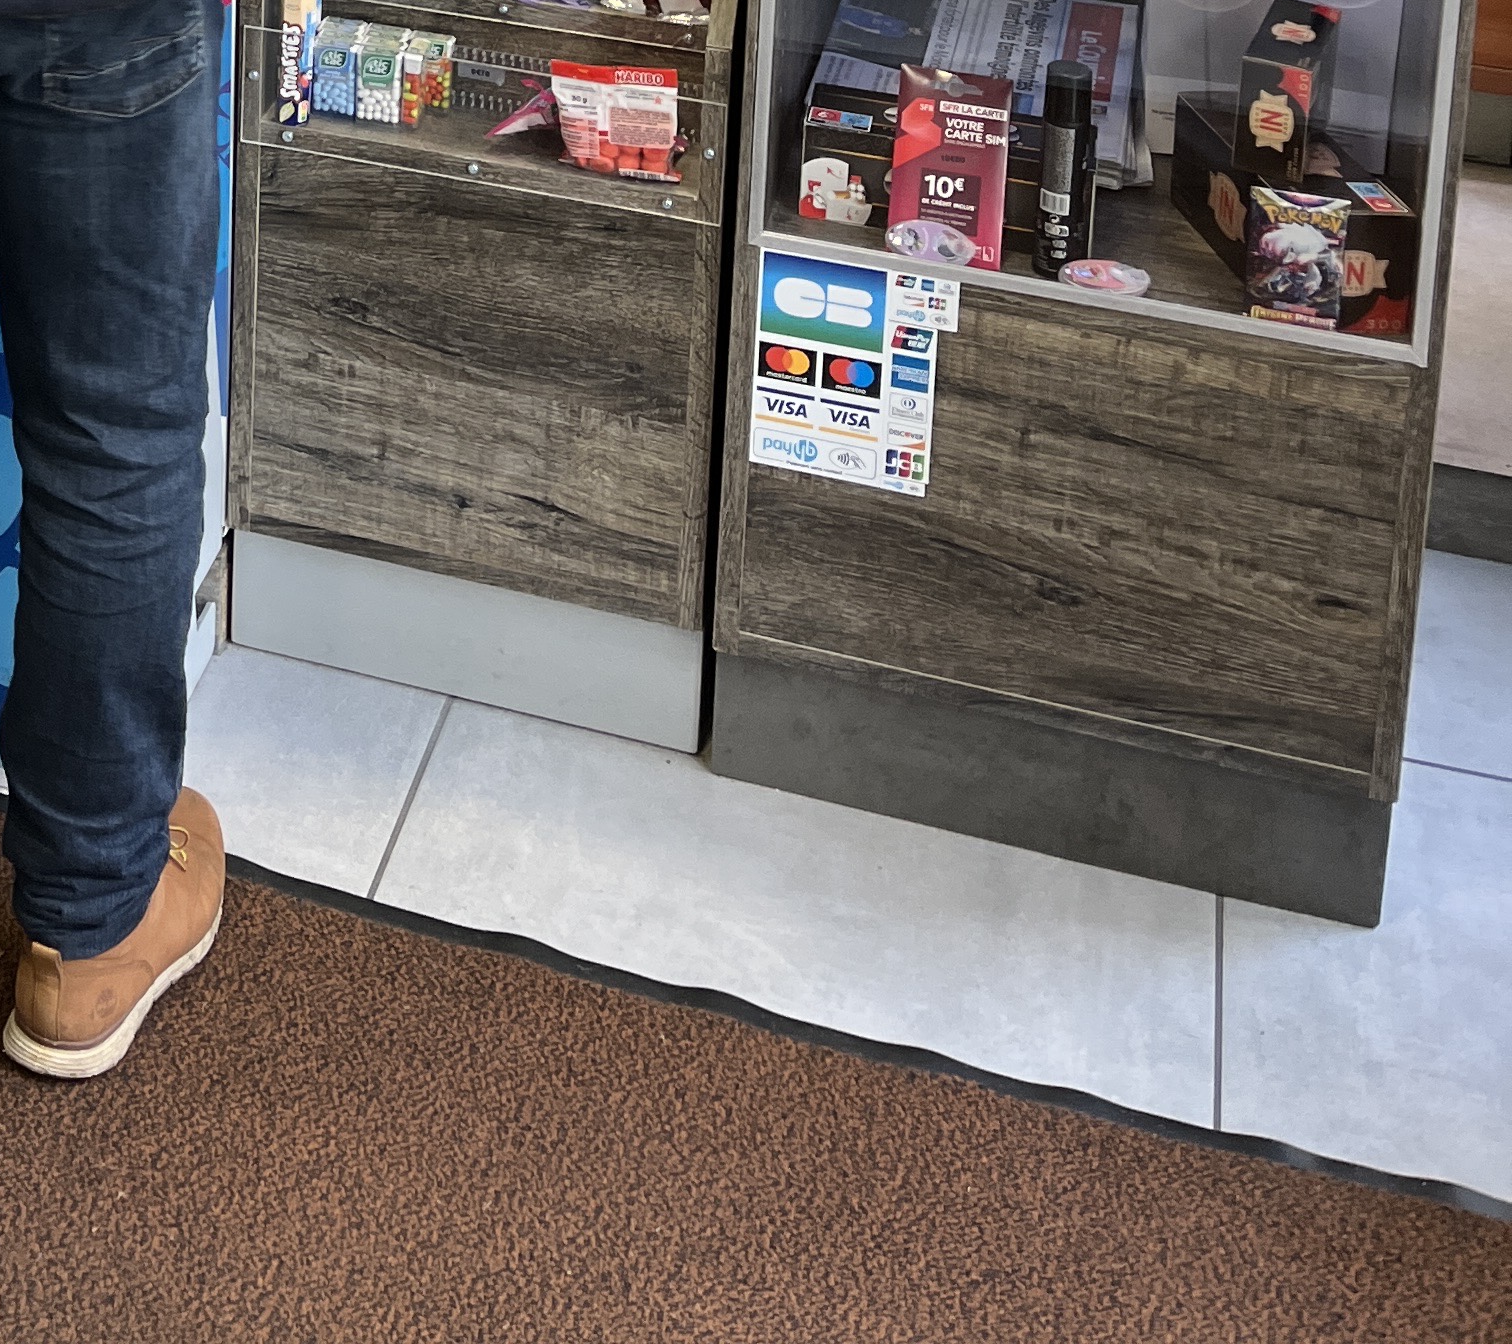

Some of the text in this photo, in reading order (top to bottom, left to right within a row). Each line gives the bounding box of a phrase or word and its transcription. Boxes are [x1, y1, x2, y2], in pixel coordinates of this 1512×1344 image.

[280, 22, 301, 101] SMARTIES
[615, 71, 664, 86] HARIBO
[1298, 73, 1309, 98] 100
[942, 103, 1005, 119] SFR LA CARTE
[945, 118, 985, 132] VOTRE
[945, 129, 1006, 146] CARTE SIM
[924, 174, 965, 199] 10€
[773, 277, 873, 328] CB
[1366, 319, 1401, 330] 300
[766, 371, 808, 383] mastercard
[835, 384, 866, 395] maestro
[762, 396, 808, 419] VISA
[827, 407, 871, 430] VISA
